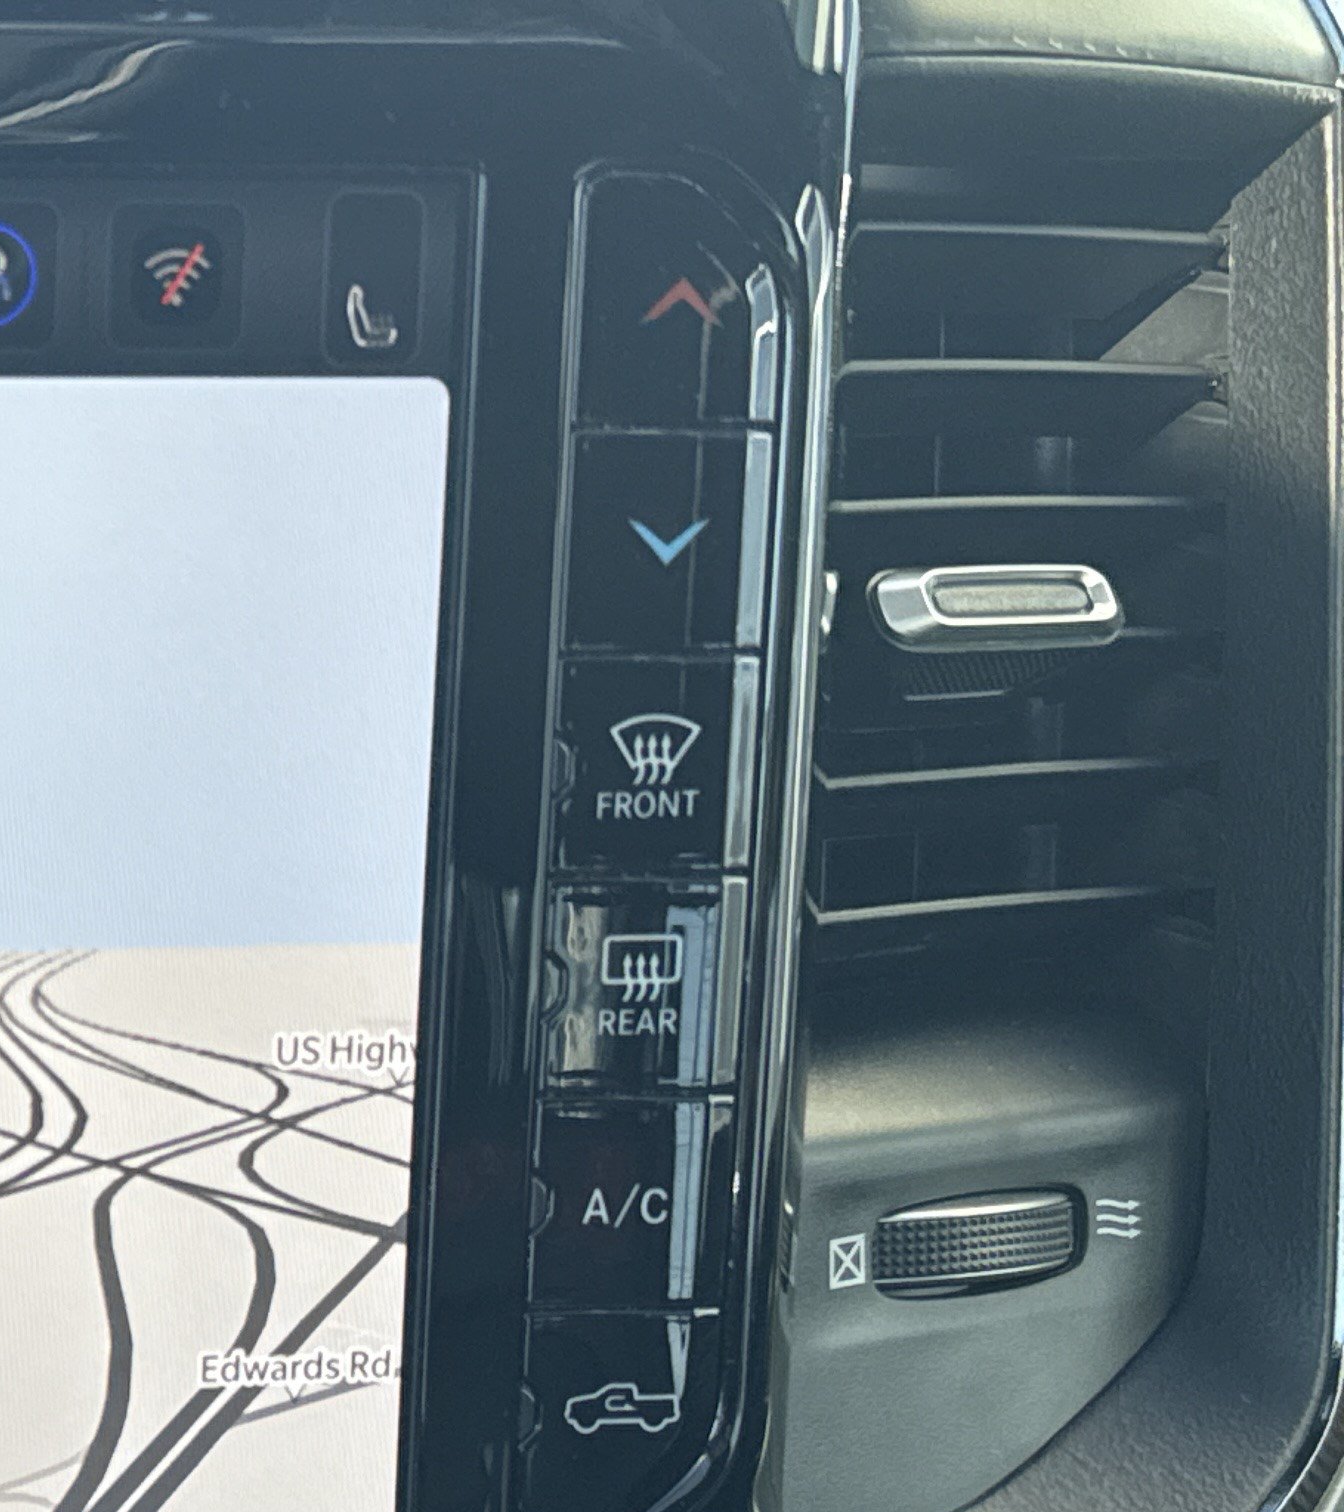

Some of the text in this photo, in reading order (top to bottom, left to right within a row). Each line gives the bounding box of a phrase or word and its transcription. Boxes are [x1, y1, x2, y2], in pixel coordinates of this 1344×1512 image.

[596, 790, 700, 820] FRONT
[598, 1009, 678, 1036] REAR
[277, 1036, 321, 1066] US
[582, 1187, 670, 1228] A/C
[201, 1354, 341, 1383] Edwards
